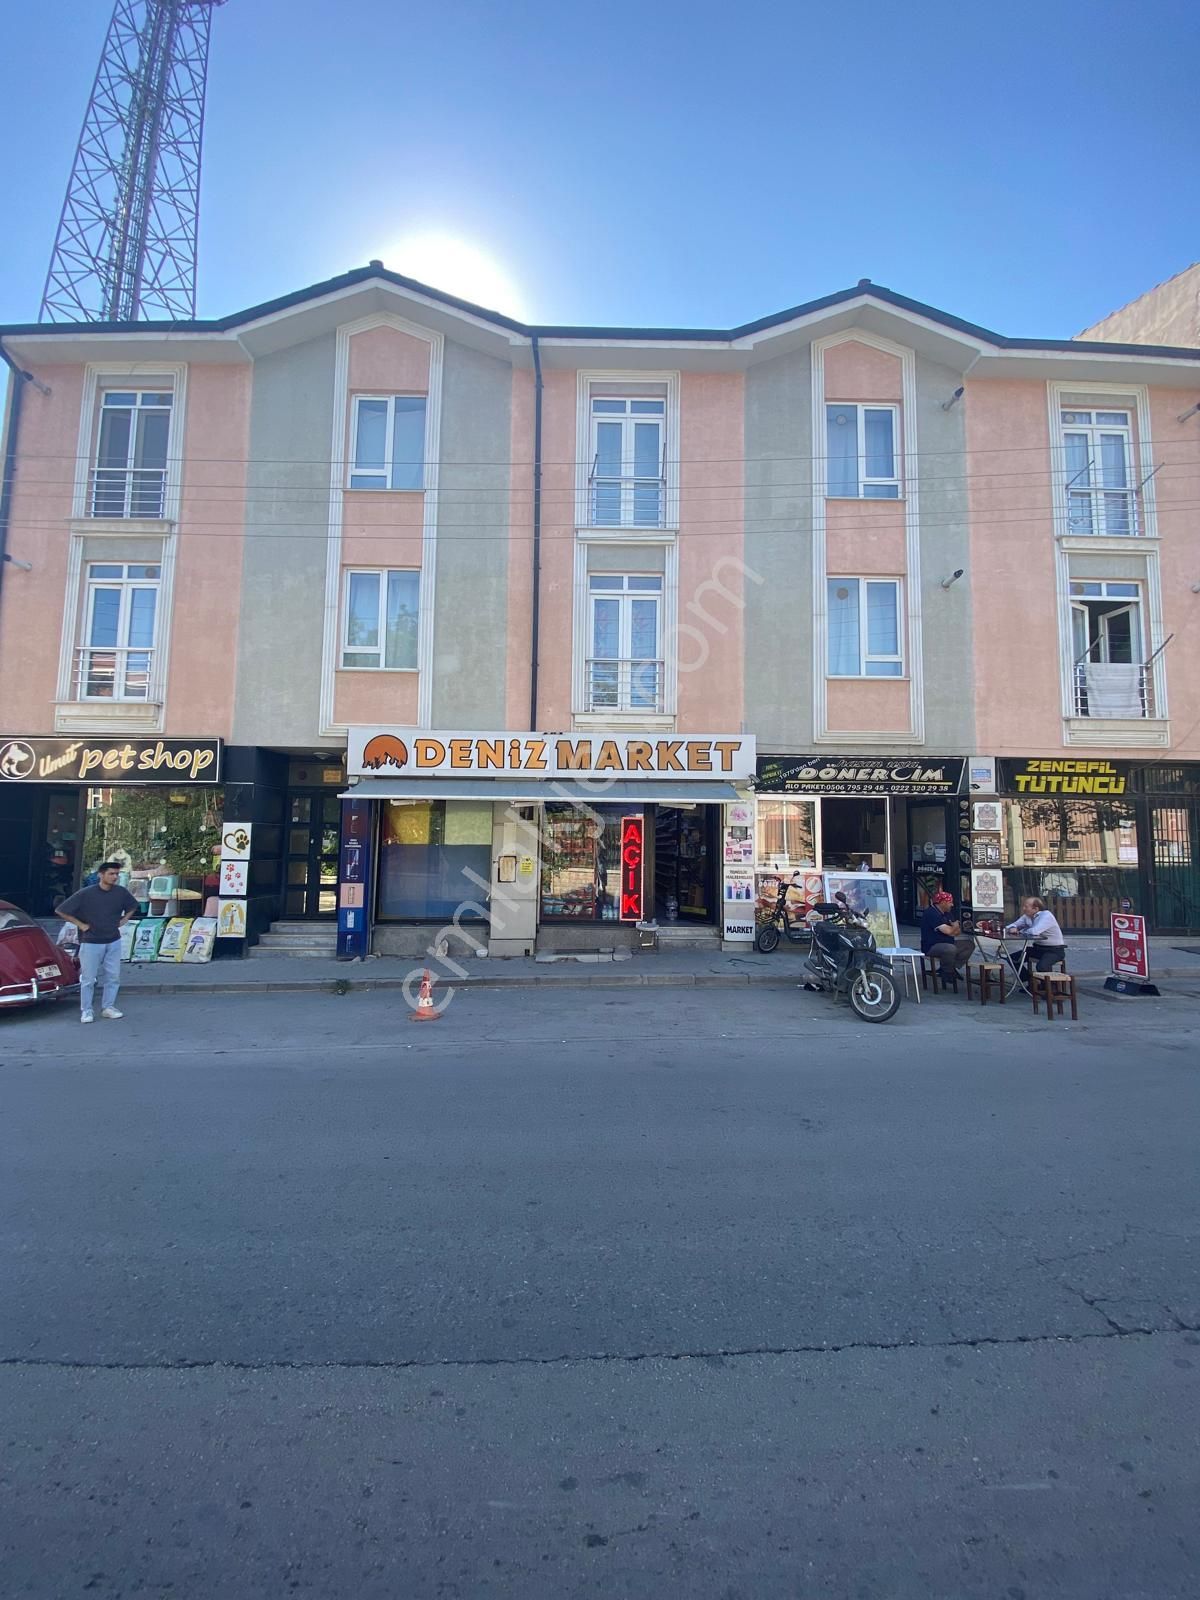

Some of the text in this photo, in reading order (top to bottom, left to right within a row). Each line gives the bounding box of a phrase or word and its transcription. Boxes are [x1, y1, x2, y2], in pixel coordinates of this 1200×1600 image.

[555, 740, 742, 772] MARKET
[1015, 775, 1126, 794] TÜTÜNCÜ
[623, 824, 641, 914] AÇIK
[726, 926, 753, 934] MARKET
